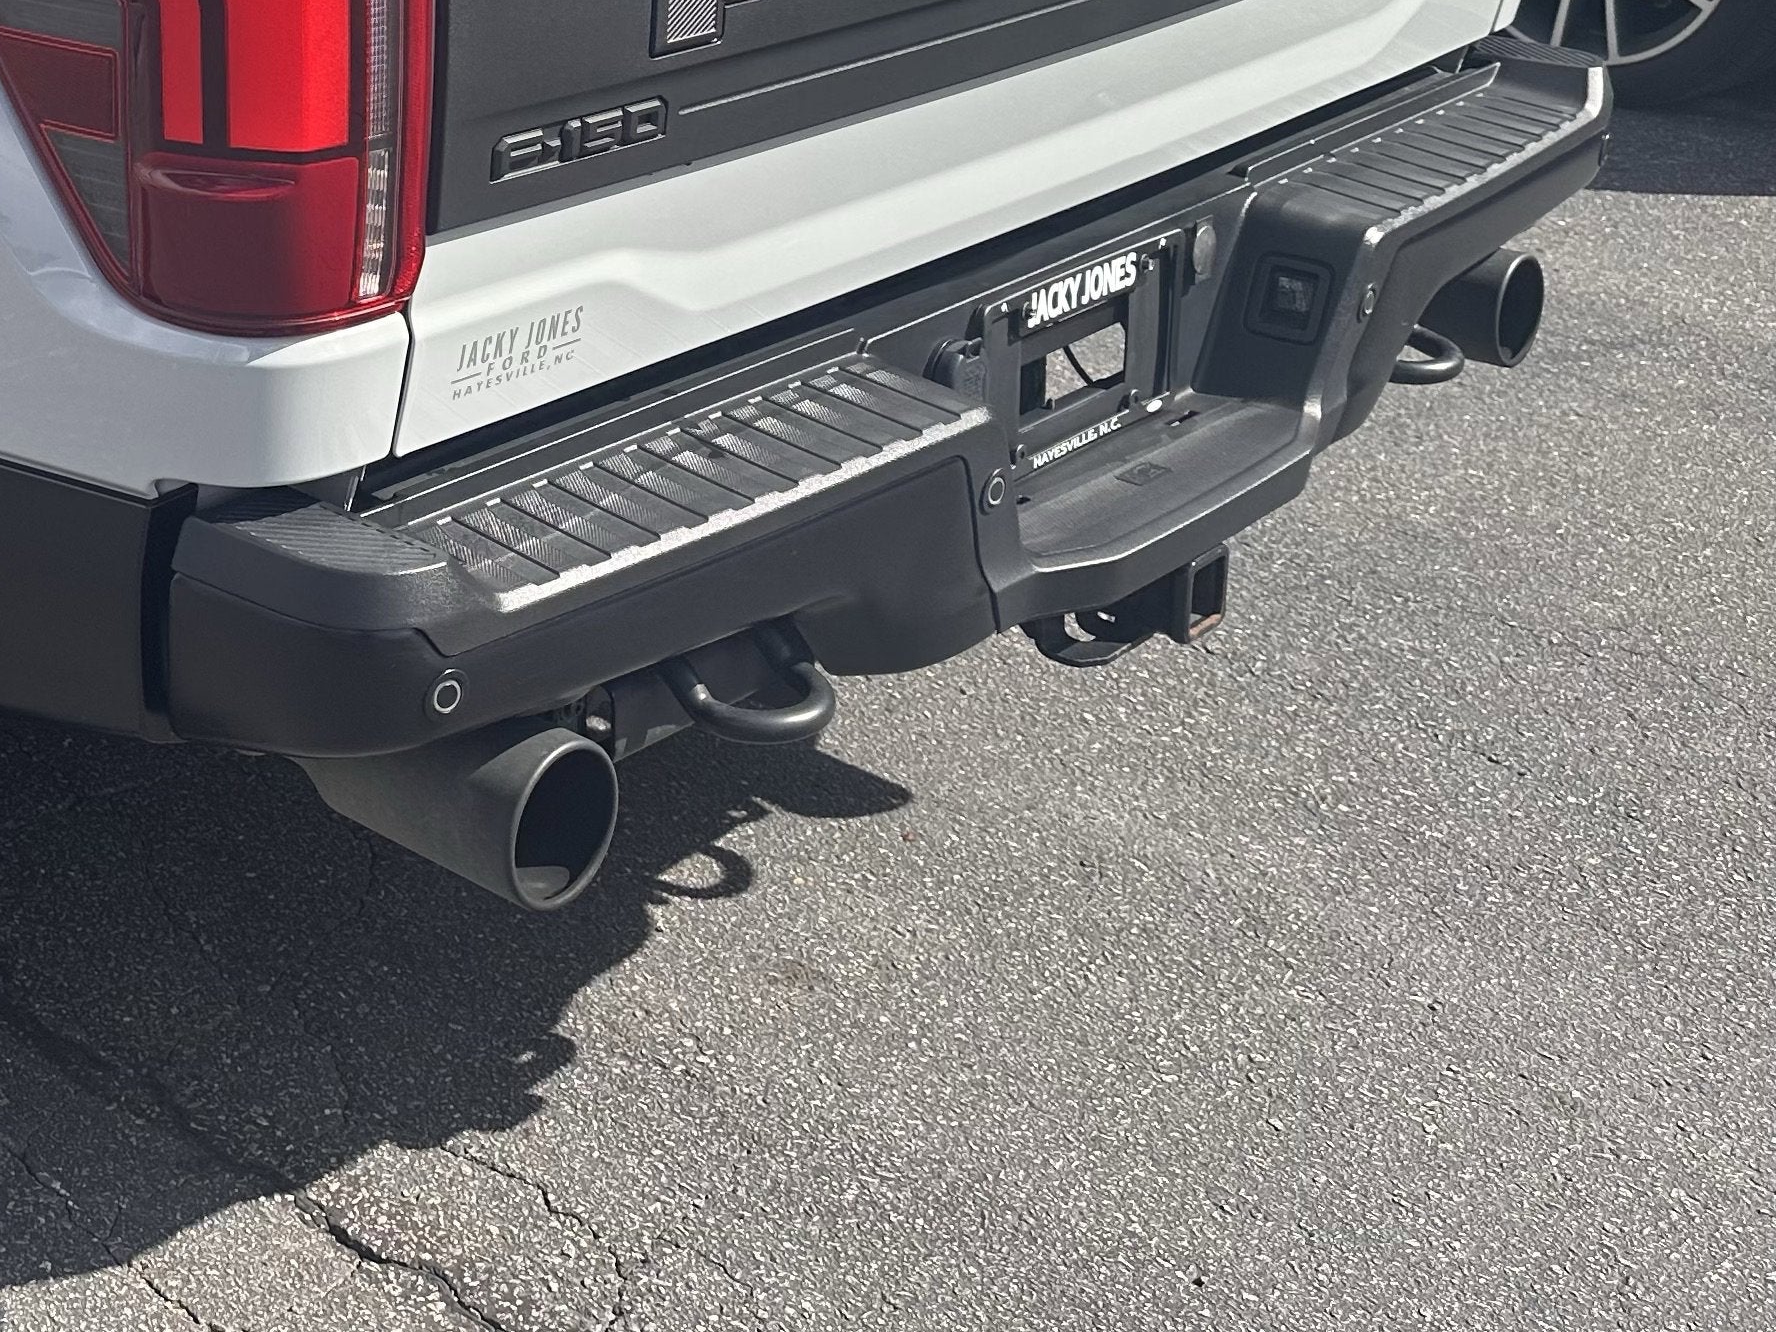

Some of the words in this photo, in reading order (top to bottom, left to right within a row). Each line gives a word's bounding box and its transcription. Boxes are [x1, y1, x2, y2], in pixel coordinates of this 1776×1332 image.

[489, 95, 669, 184] F-150
[1027, 272, 1083, 329] JACKY
[1081, 251, 1137, 305] JONES
[456, 326, 520, 373] JACKY
[525, 305, 585, 351] JONES
[486, 344, 549, 377] FORD
[451, 359, 552, 401] HAYESVILLE,
[553, 349, 575, 366] NC
[1099, 415, 1122, 437] N.C.
